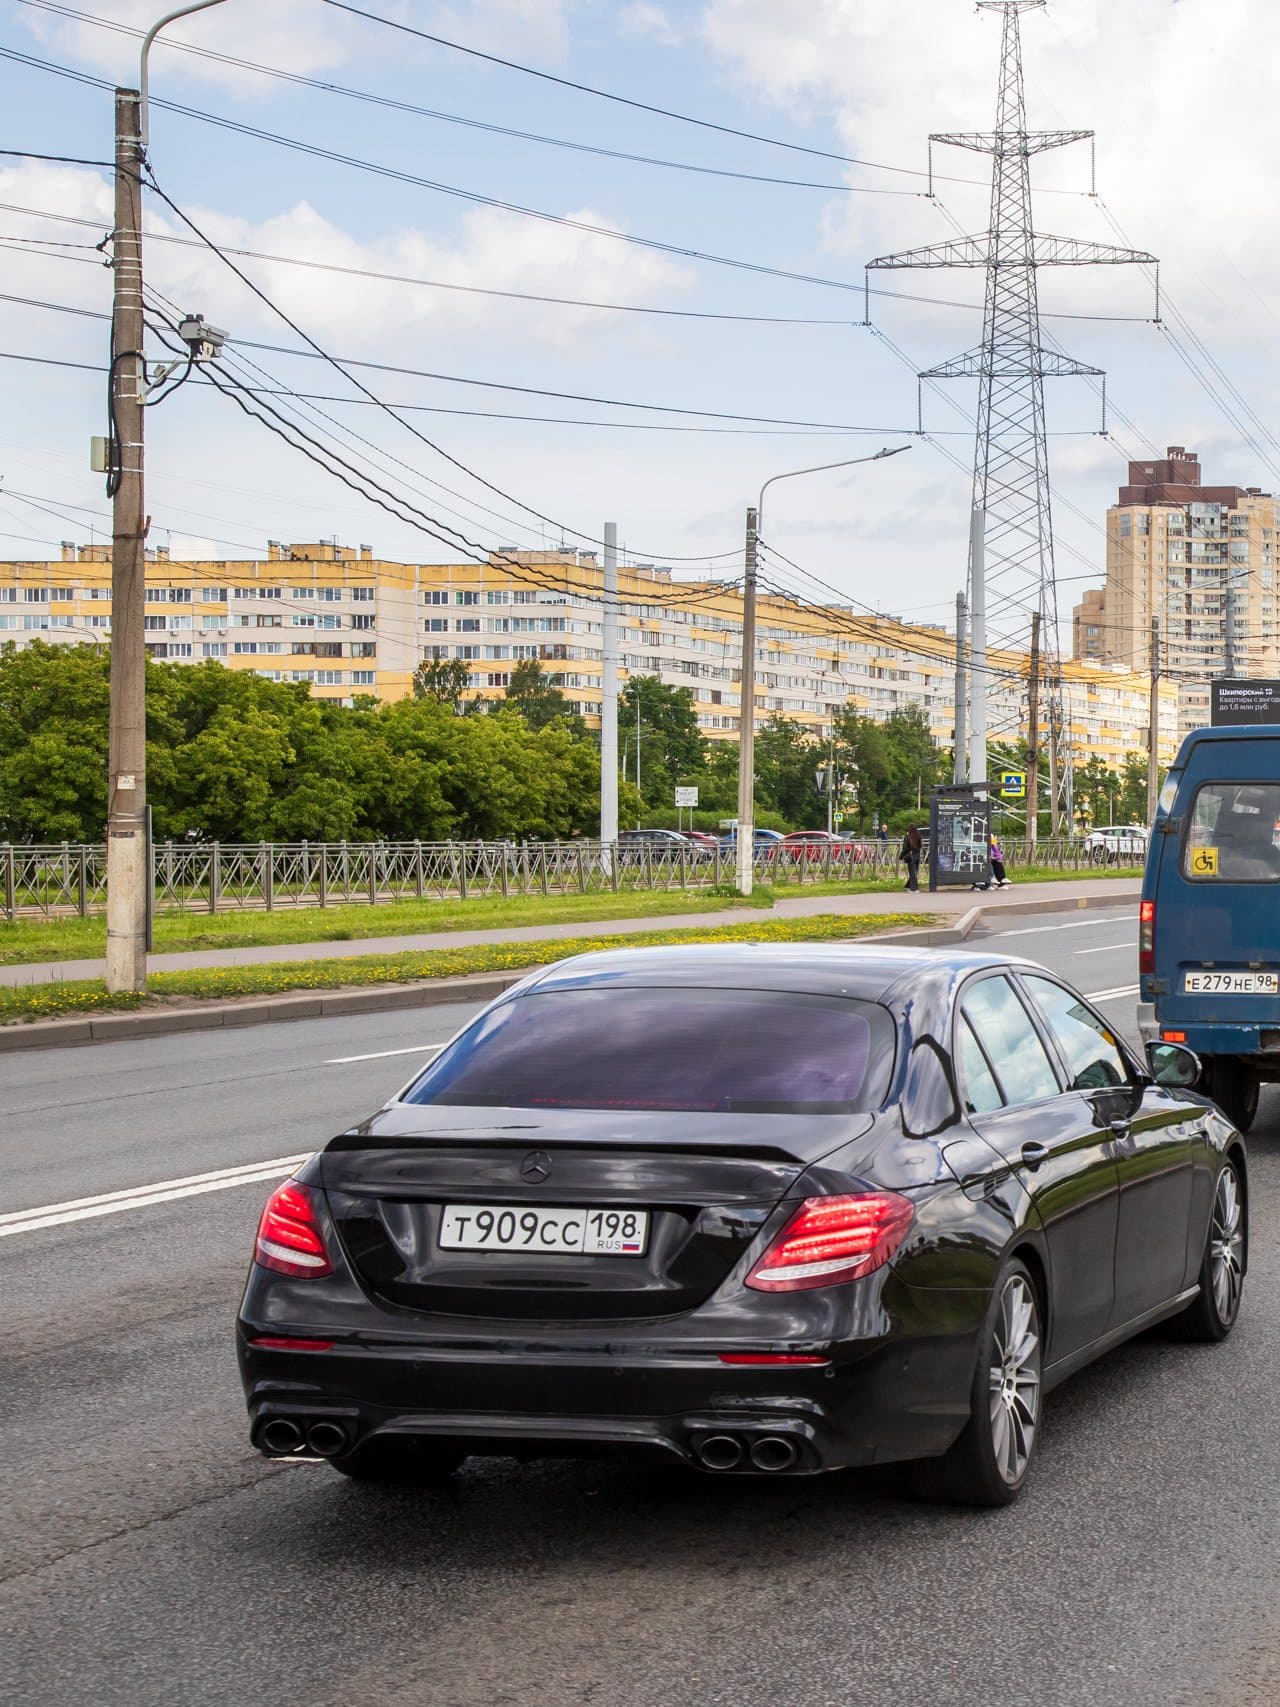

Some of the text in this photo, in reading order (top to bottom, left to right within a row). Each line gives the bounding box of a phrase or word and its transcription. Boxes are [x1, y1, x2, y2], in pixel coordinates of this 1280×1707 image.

[1219, 688, 1264, 697] Шкиперский
[1257, 975, 1272, 987] 98
[455, 1210, 637, 1246] Т909СС 198
[597, 1240, 622, 1250] RUS
